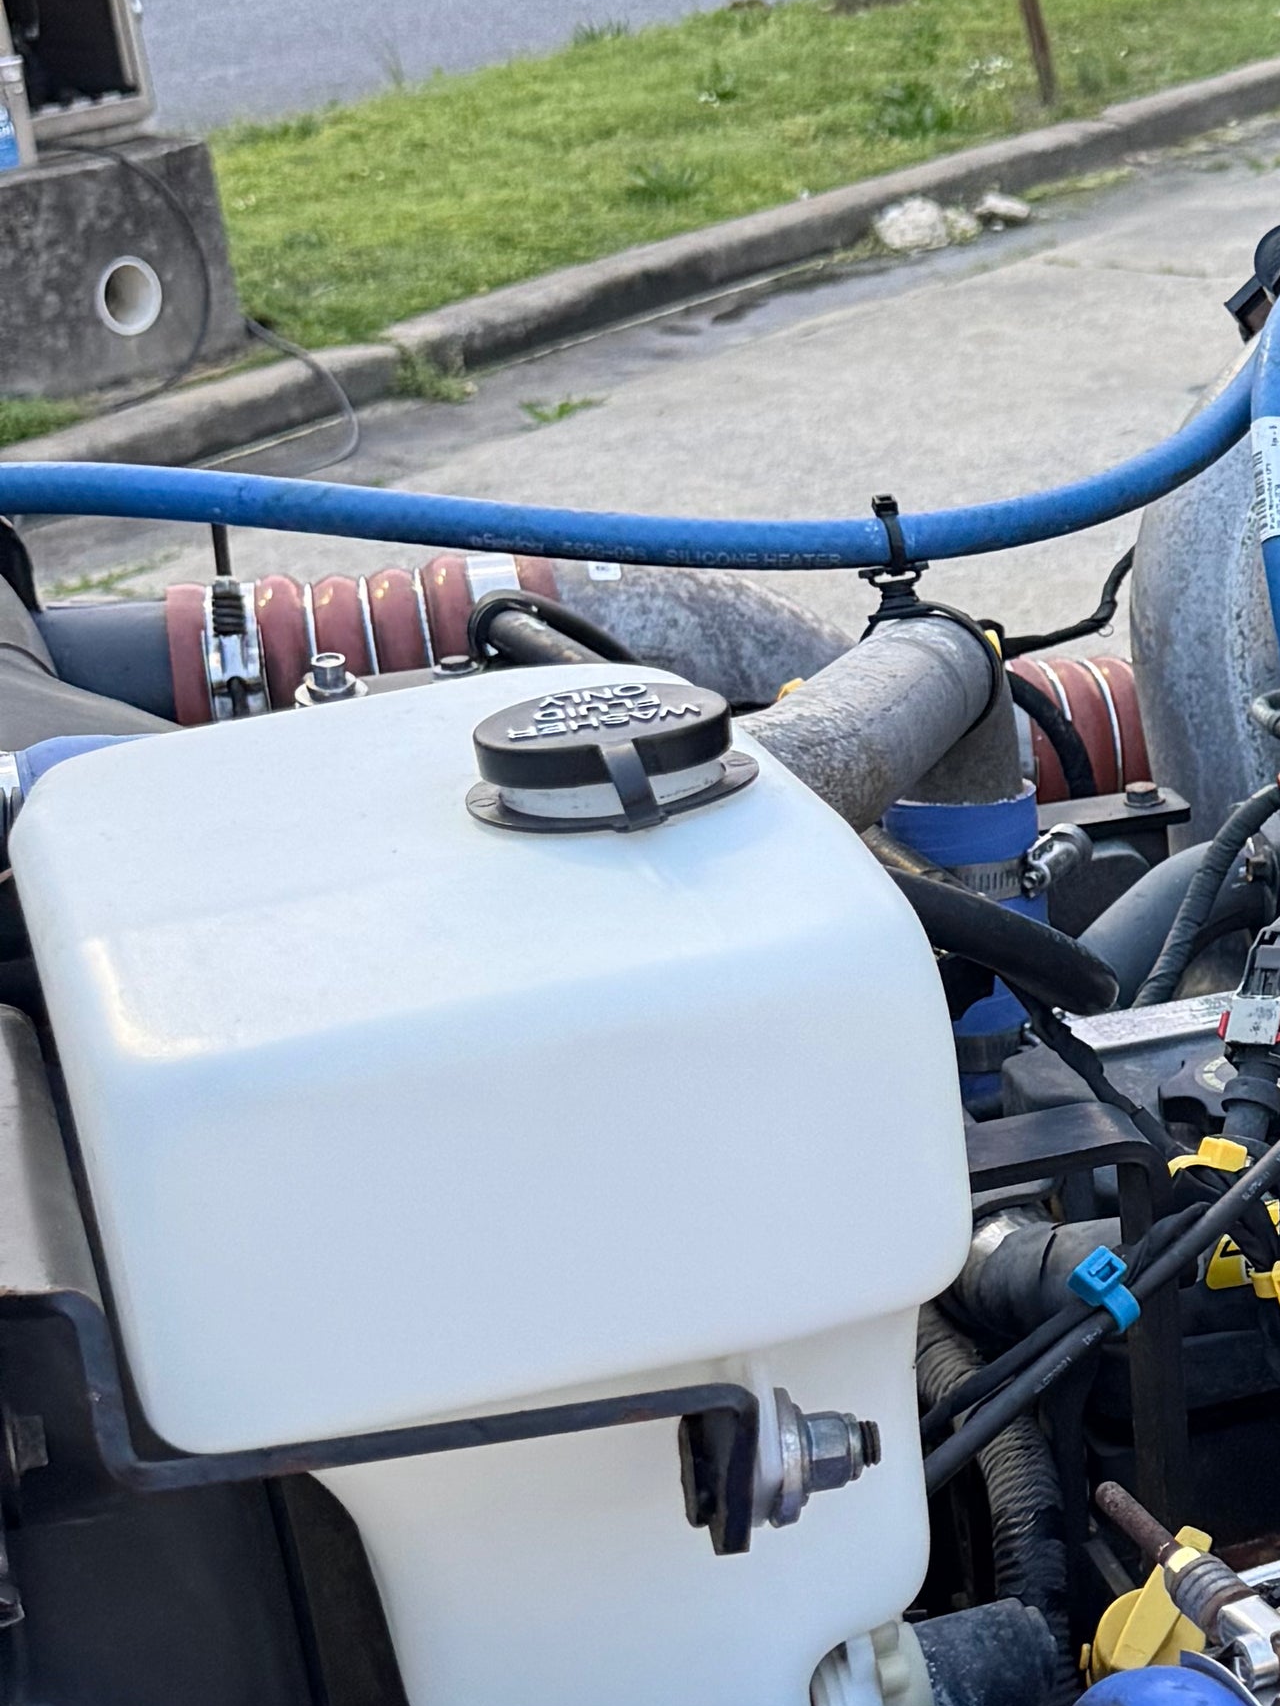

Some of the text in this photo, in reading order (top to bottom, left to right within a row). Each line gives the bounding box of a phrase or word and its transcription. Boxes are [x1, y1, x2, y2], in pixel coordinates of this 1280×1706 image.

[665, 548, 758, 567] SILICONE
[761, 553, 842, 567] HEATER
[533, 695, 661, 721] FLUID
[538, 683, 648, 708] ONLY
[507, 702, 701, 740] WASHER
